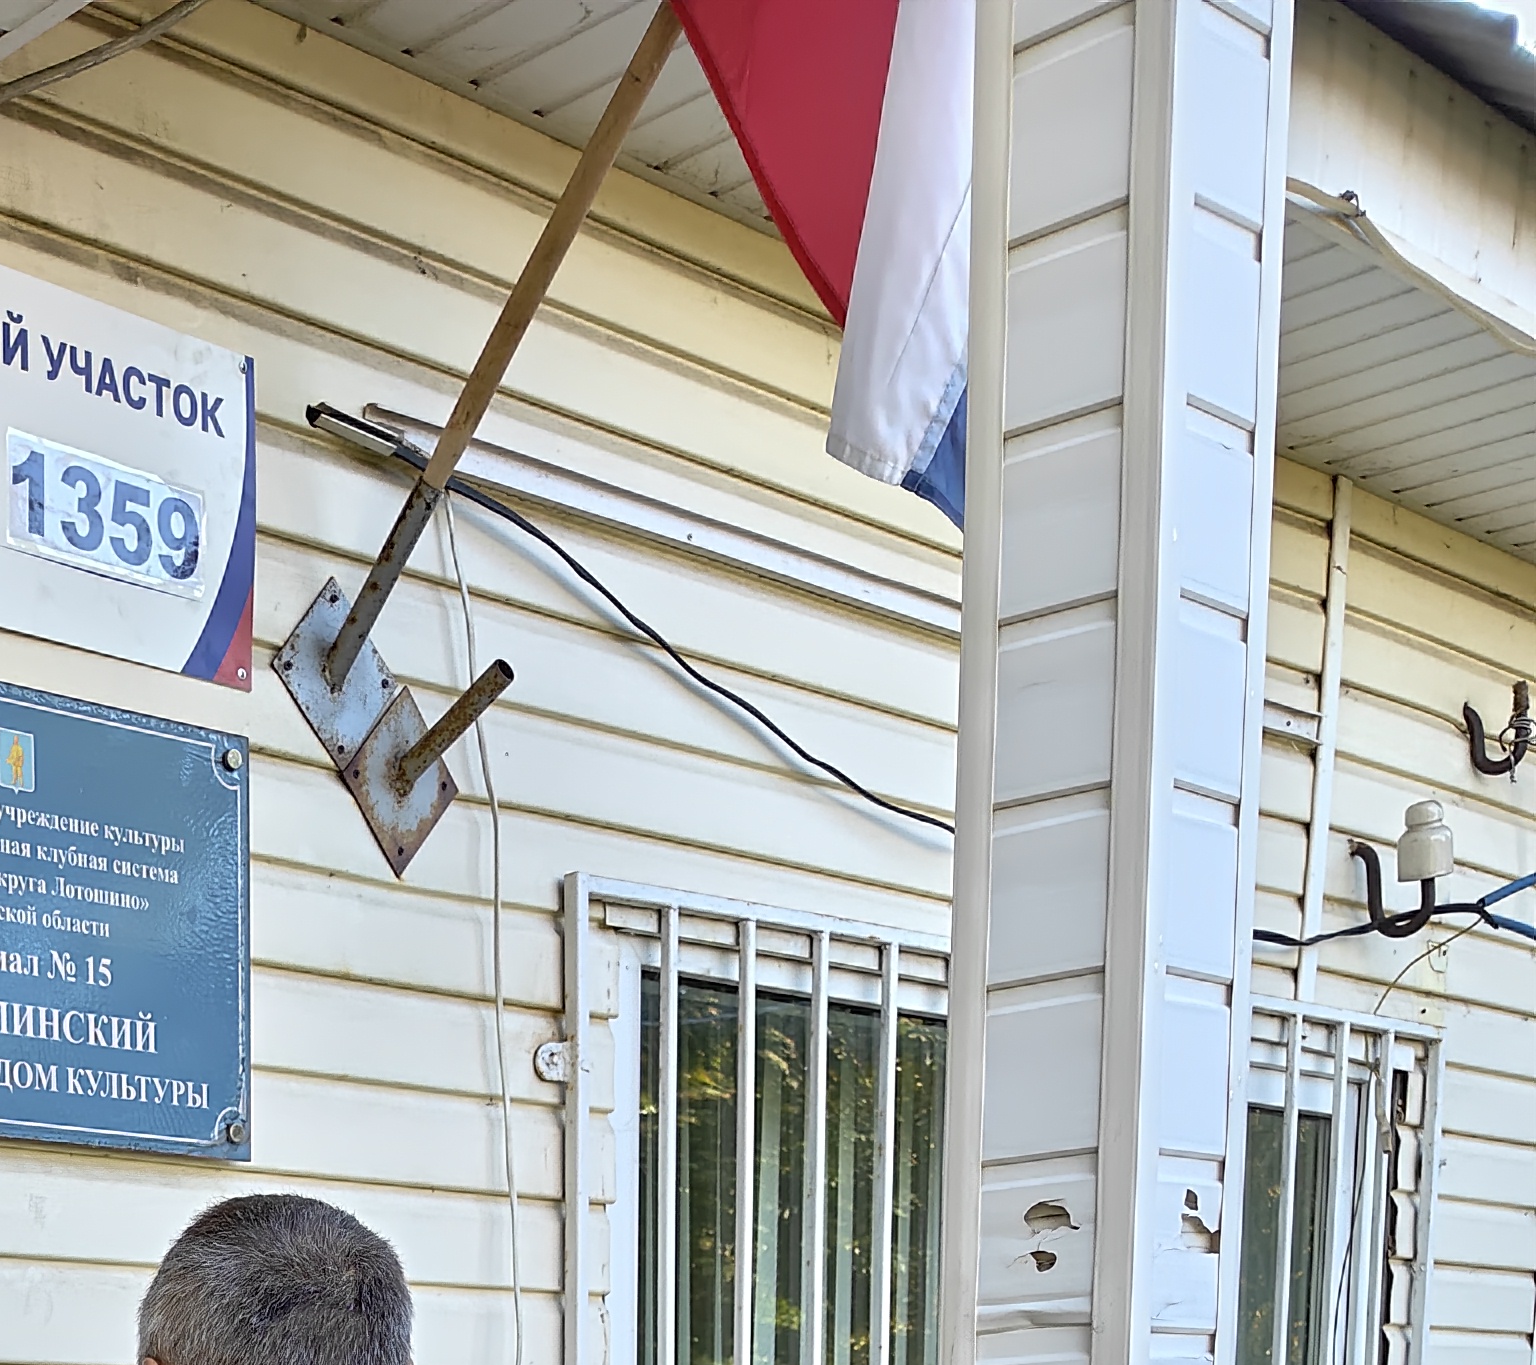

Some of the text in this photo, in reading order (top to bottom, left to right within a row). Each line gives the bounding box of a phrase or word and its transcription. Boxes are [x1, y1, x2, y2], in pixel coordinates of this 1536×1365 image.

[41, 334, 225, 438] УЧАСТОК
[11, 451, 199, 581] 1359
[104, 821, 185, 857] культуры
[37, 841, 108, 873] клубная
[113, 857, 179, 885] система
[51, 877, 150, 912] Лотошино»
[42, 908, 110, 938] области
[47, 949, 77, 983] №
[85, 956, 113, 987] 15
[66, 1067, 209, 1109] КУЛЬТУРЫ
